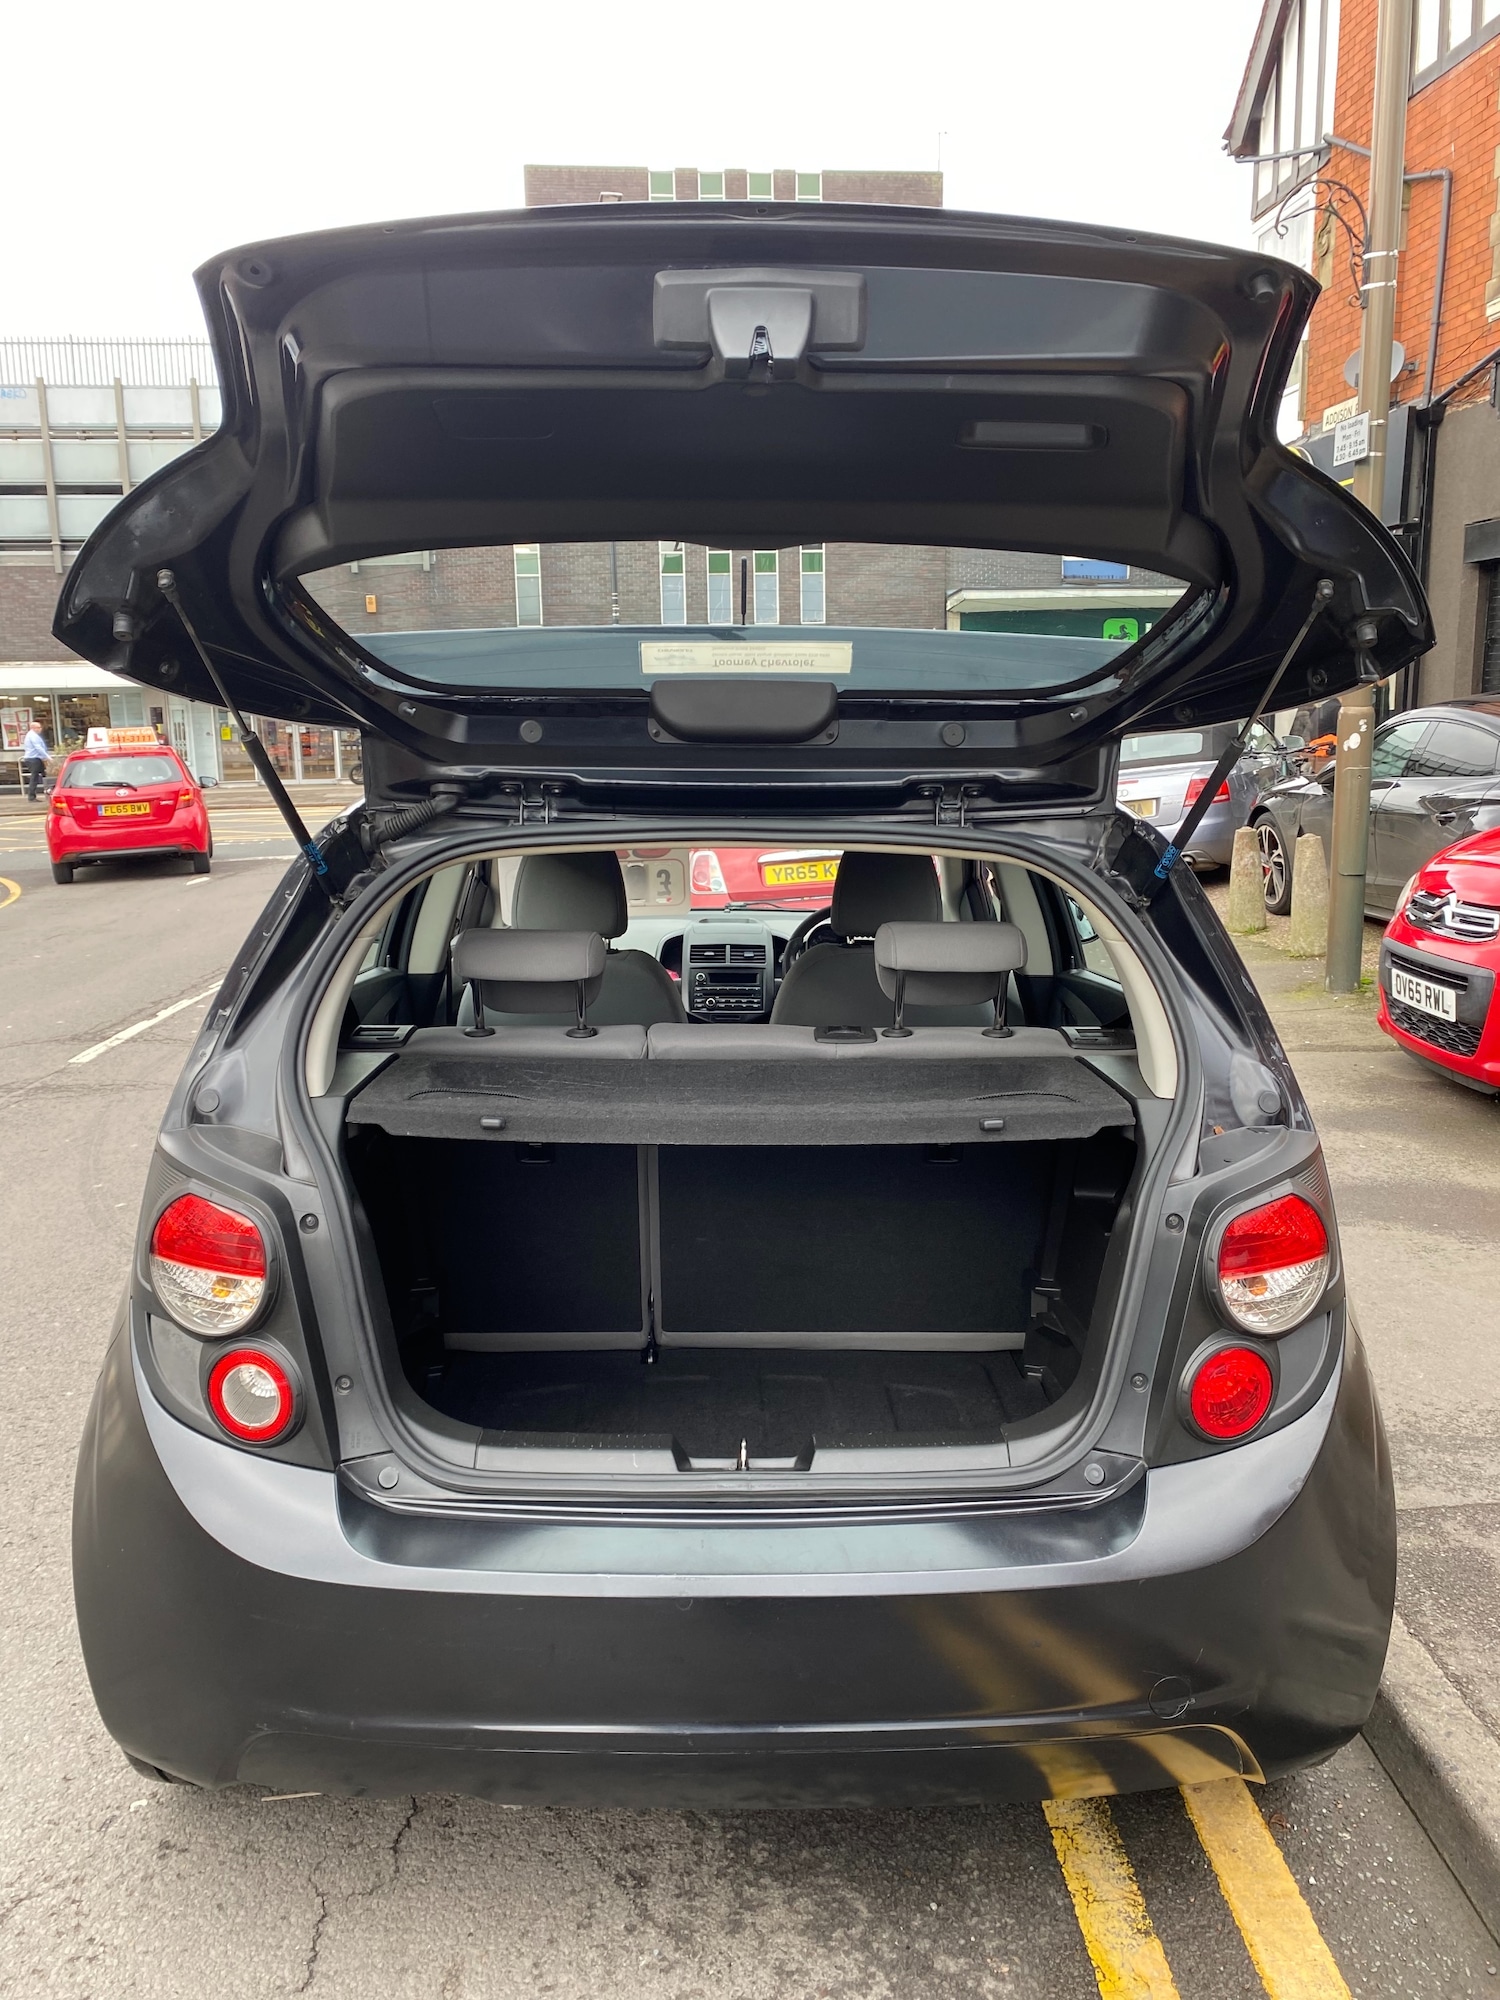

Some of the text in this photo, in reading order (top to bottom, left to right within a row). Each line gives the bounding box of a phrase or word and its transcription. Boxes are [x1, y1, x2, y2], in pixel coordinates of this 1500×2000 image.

[1325, 406, 1353, 426] ADDISON
[1348, 419, 1363, 429] loading
[93, 733, 103, 742] L
[103, 803, 148, 815] FL65 BWV
[772, 861, 839, 882] YR65 K
[1395, 973, 1450, 1015] OV65 RWL
